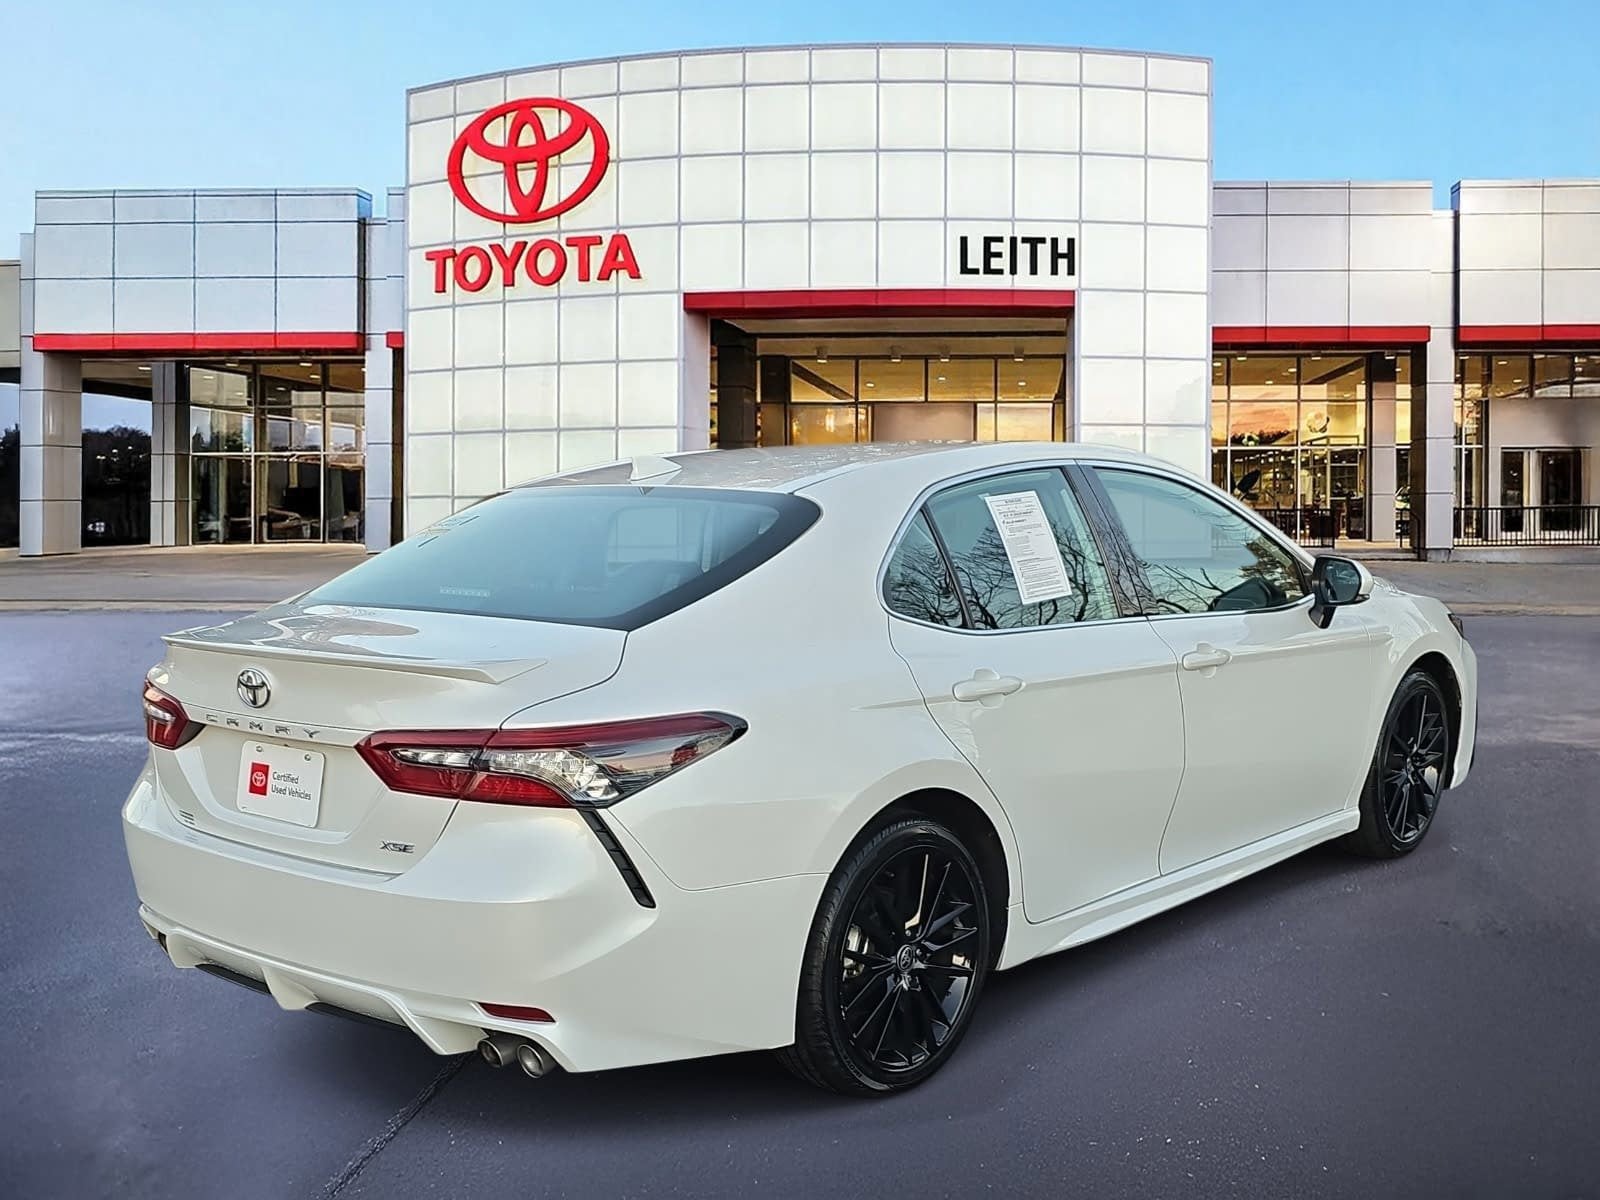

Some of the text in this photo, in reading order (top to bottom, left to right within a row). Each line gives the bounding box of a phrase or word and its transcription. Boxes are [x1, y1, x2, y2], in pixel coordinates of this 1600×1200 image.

[426, 233, 641, 293] TOYOTA
[960, 236, 1075, 275] LEITH
[205, 713, 320, 738] CAMRY
[272, 771, 300, 784] Certified
[271, 784, 312, 800] Used Vehicles
[379, 841, 415, 854] XSE
